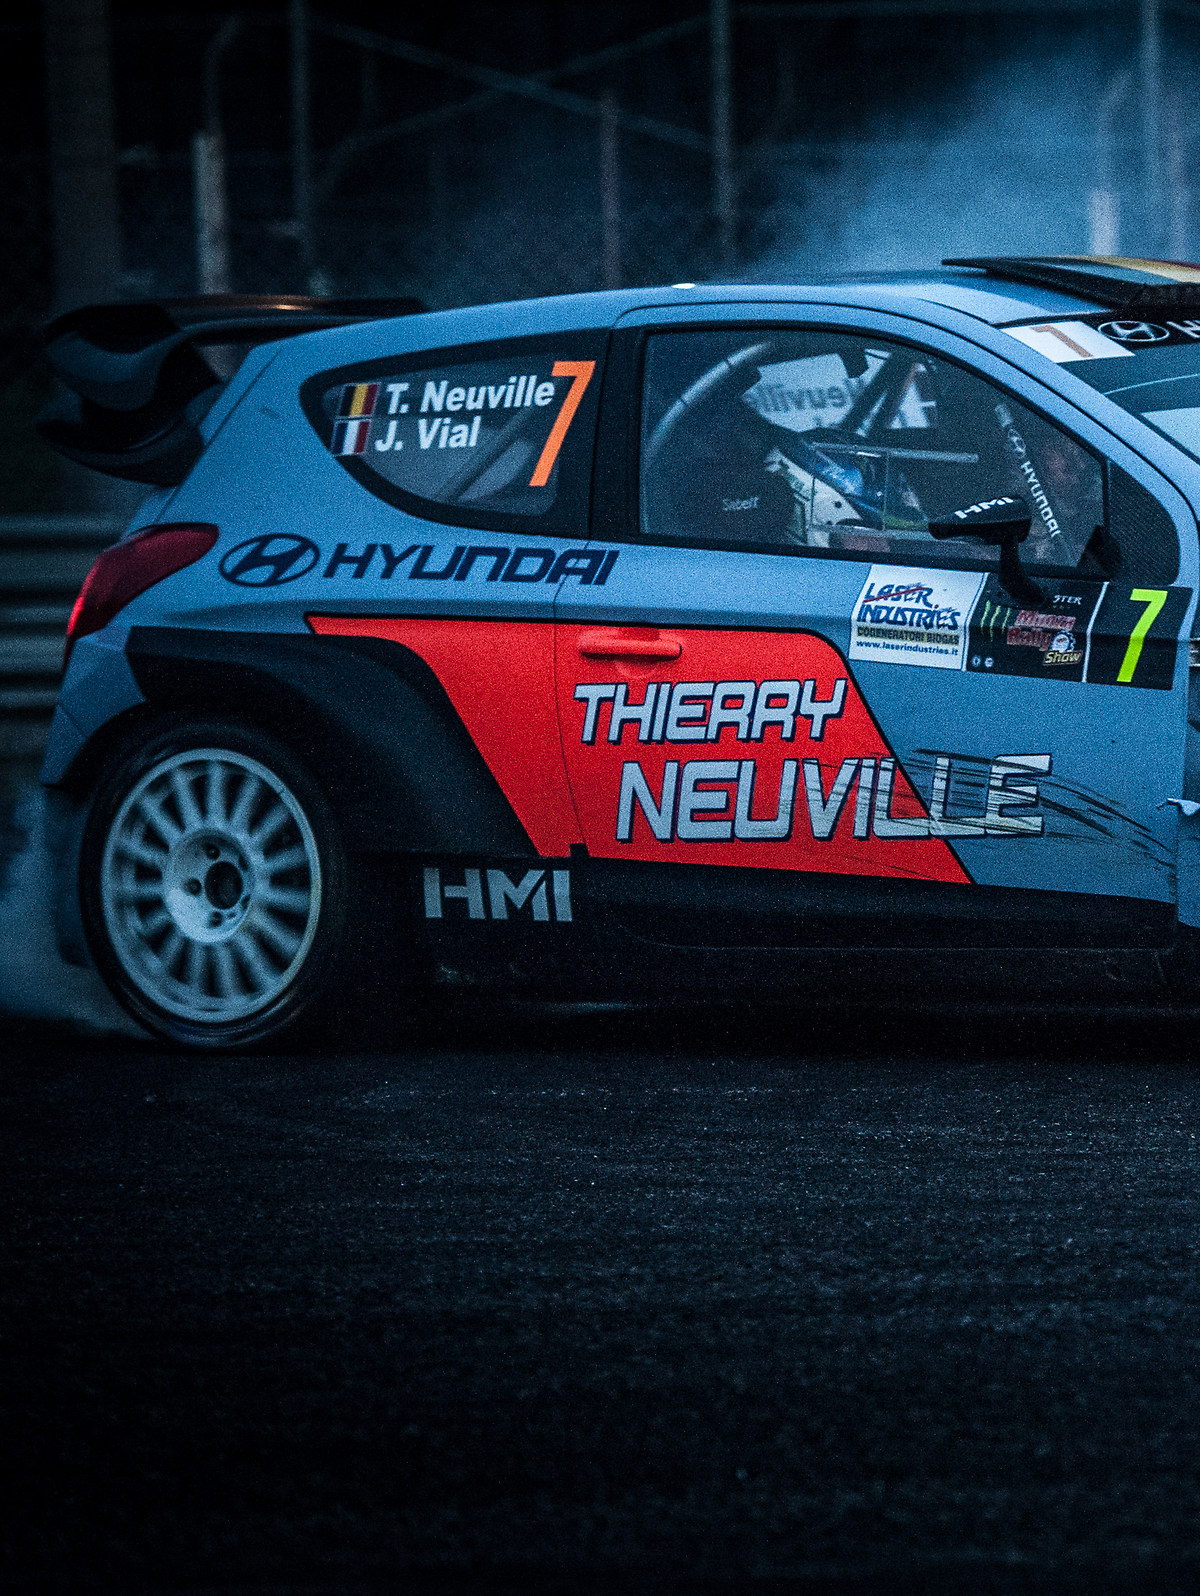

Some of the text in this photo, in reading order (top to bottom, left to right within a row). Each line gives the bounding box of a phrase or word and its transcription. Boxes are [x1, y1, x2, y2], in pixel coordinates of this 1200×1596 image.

[386, 375, 556, 414] T. Neuville
[375, 417, 481, 452] J. Vial
[529, 360, 596, 487] 7
[954, 497, 1014, 519] HMI
[1021, 460, 1061, 538] HYUNDAI
[324, 542, 620, 586] HYUNDAI
[862, 582, 934, 608] LASER
[857, 604, 961, 630] INDUSTRIES
[1117, 588, 1168, 683] 7
[856, 641, 959, 656] www.laserindustries.it
[1044, 651, 1082, 664] Show
[573, 677, 848, 745] THIERRY
[615, 752, 1053, 843] NEUVILLE
[423, 866, 574, 922] HMI
